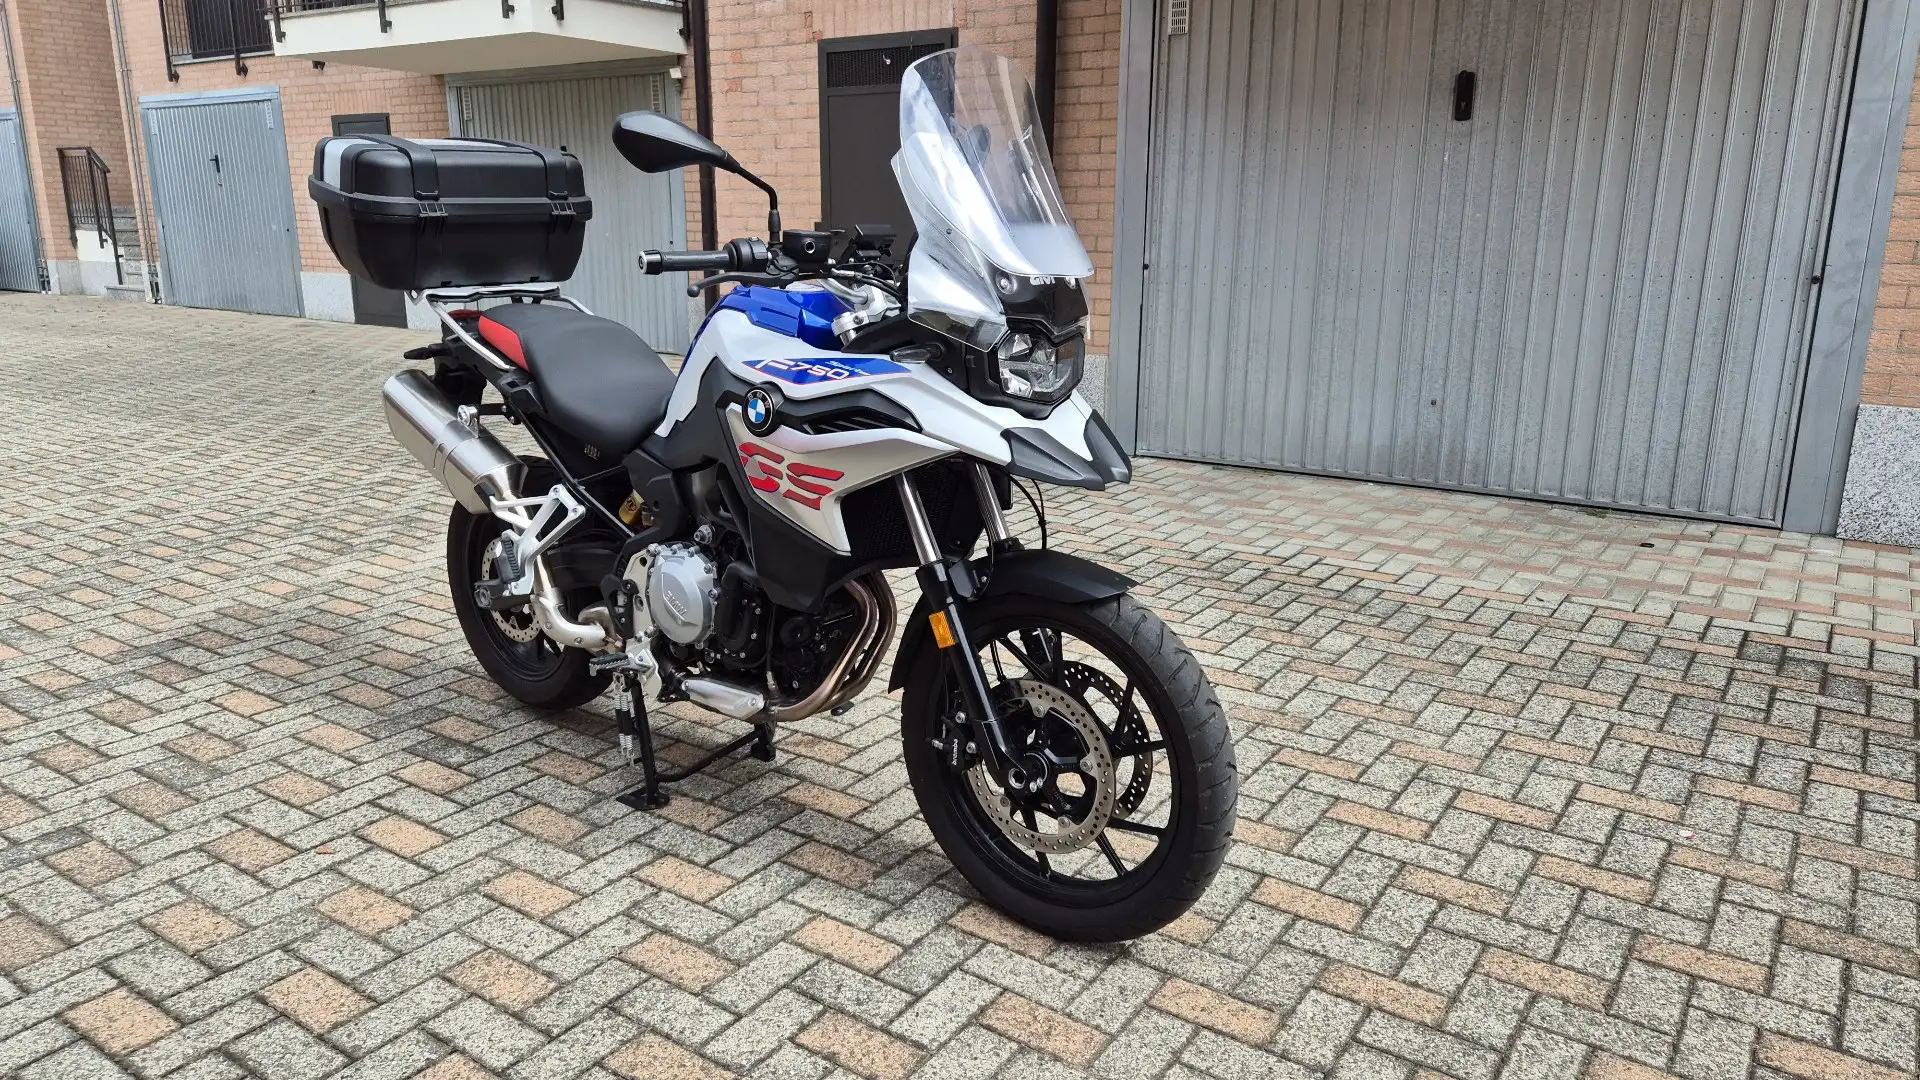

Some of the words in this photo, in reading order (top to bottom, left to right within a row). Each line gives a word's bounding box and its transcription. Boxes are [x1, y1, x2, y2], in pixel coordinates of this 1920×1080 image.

[747, 391, 771, 409] BMW
[738, 441, 845, 511] GS
[951, 738, 959, 766] brembo
